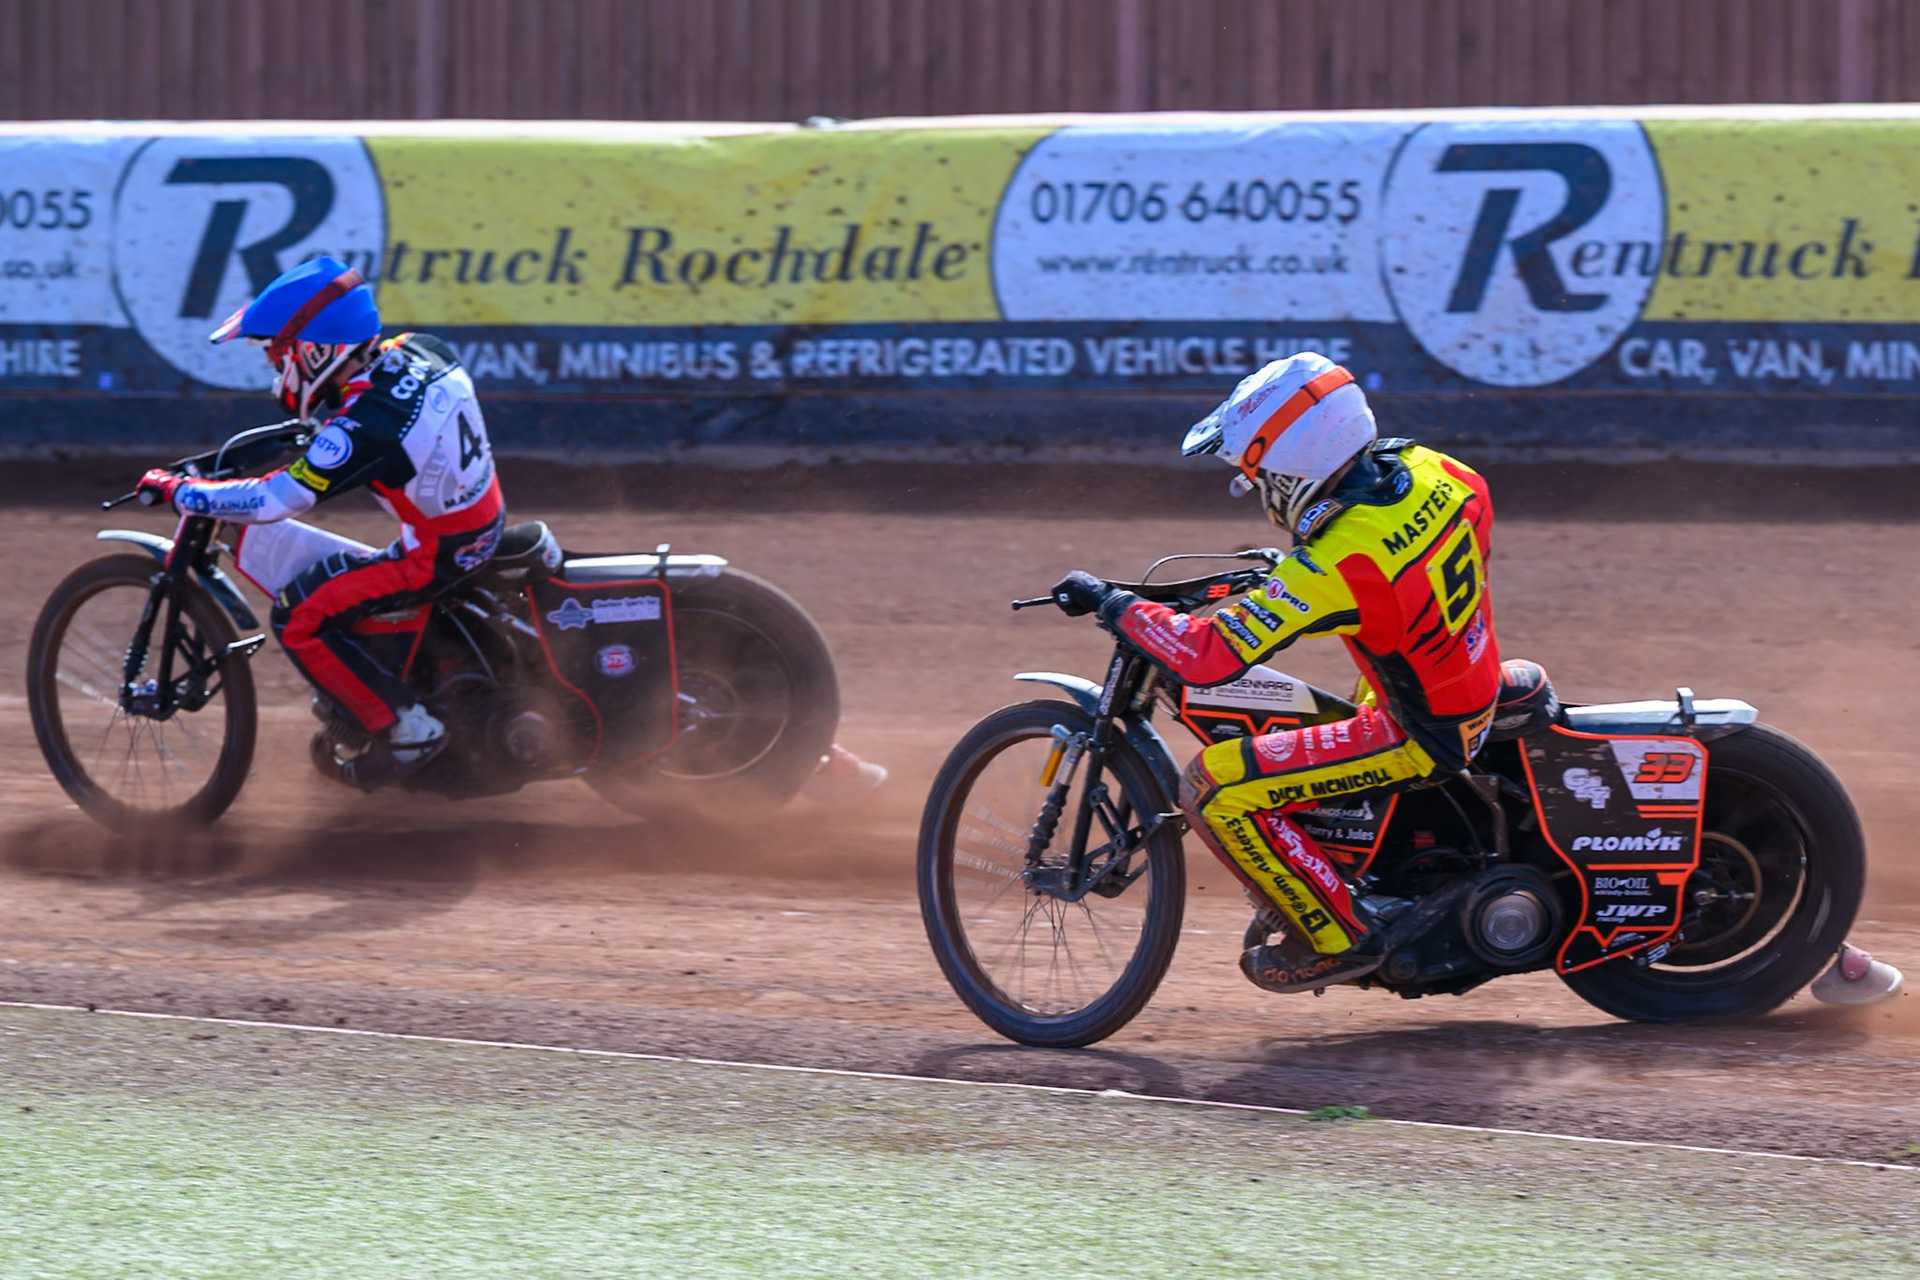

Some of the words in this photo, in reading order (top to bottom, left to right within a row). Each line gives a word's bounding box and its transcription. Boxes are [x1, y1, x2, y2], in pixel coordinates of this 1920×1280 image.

[0, 189, 91, 229] 0055
[1031, 181, 1168, 223] 01706
[1181, 181, 1362, 223] 640055
[617, 222, 968, 285] Rochdale
[0, 339, 80, 376] HIRE
[558, 342, 738, 380] MINIBUS
[750, 341, 783, 379] &
[791, 337, 1075, 376] REFRIGERATED
[1083, 337, 1248, 375] VEHICLE
[1618, 338, 1717, 385] CAR,
[1725, 338, 1835, 385] VAN,
[458, 410, 484, 472] 4
[1381, 480, 1453, 555] MASTERS
[1441, 530, 1477, 624] 5
[1280, 590, 1310, 613] PRO
[1267, 784, 1307, 805] DICK
[1309, 768, 1393, 796] MCNICOLL
[1633, 752, 1696, 784] 33
[1595, 904, 1668, 918] JWP
